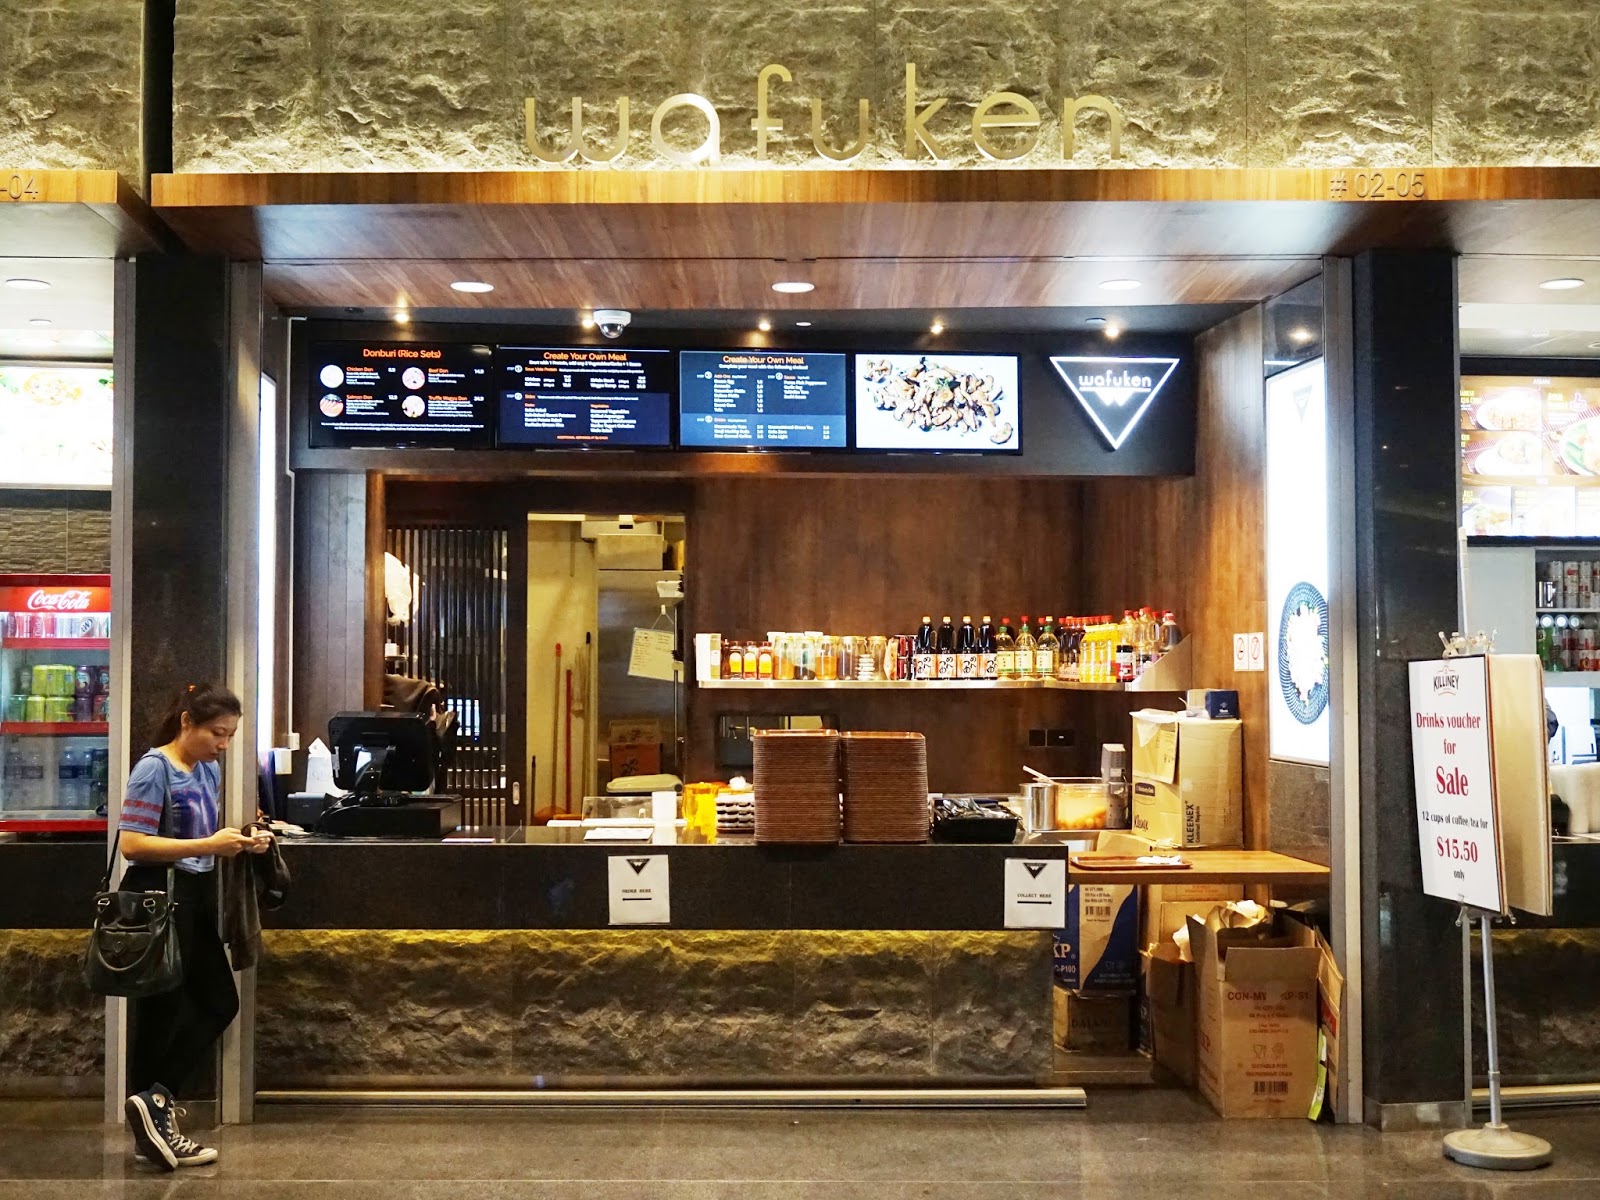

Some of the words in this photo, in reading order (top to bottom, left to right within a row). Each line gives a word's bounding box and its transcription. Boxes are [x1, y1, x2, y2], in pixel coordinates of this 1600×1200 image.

[525, 62, 1121, 166] wafuken
[1354, 171, 1426, 198] 02-05
[362, 348, 396, 358] Donburi
[398, 349, 418, 359] (Rice
[420, 350, 442, 359] Sets)
[543, 352, 568, 360] Create
[570, 352, 587, 361] Your
[588, 353, 606, 361] Own
[608, 353, 627, 361] Meal
[722, 356, 748, 364] Create
[1078, 370, 1152, 387] wafuken
[27, 590, 92, 610] Coca-Cola
[1433, 675, 1459, 692] KILLINEY
[1416, 712, 1444, 728] Drinks
[1447, 713, 1481, 729] voucher
[1444, 738, 1456, 754] for
[1436, 765, 1468, 796] Sale
[1186, 804, 1194, 843] KLEENEX
[1422, 811, 1429, 821] 12
[1431, 814, 1444, 824] cups
[1445, 814, 1451, 824] of
[1480, 817, 1488, 829] for
[1437, 836, 1478, 863] $15.50
[1454, 869, 1465, 881] only
